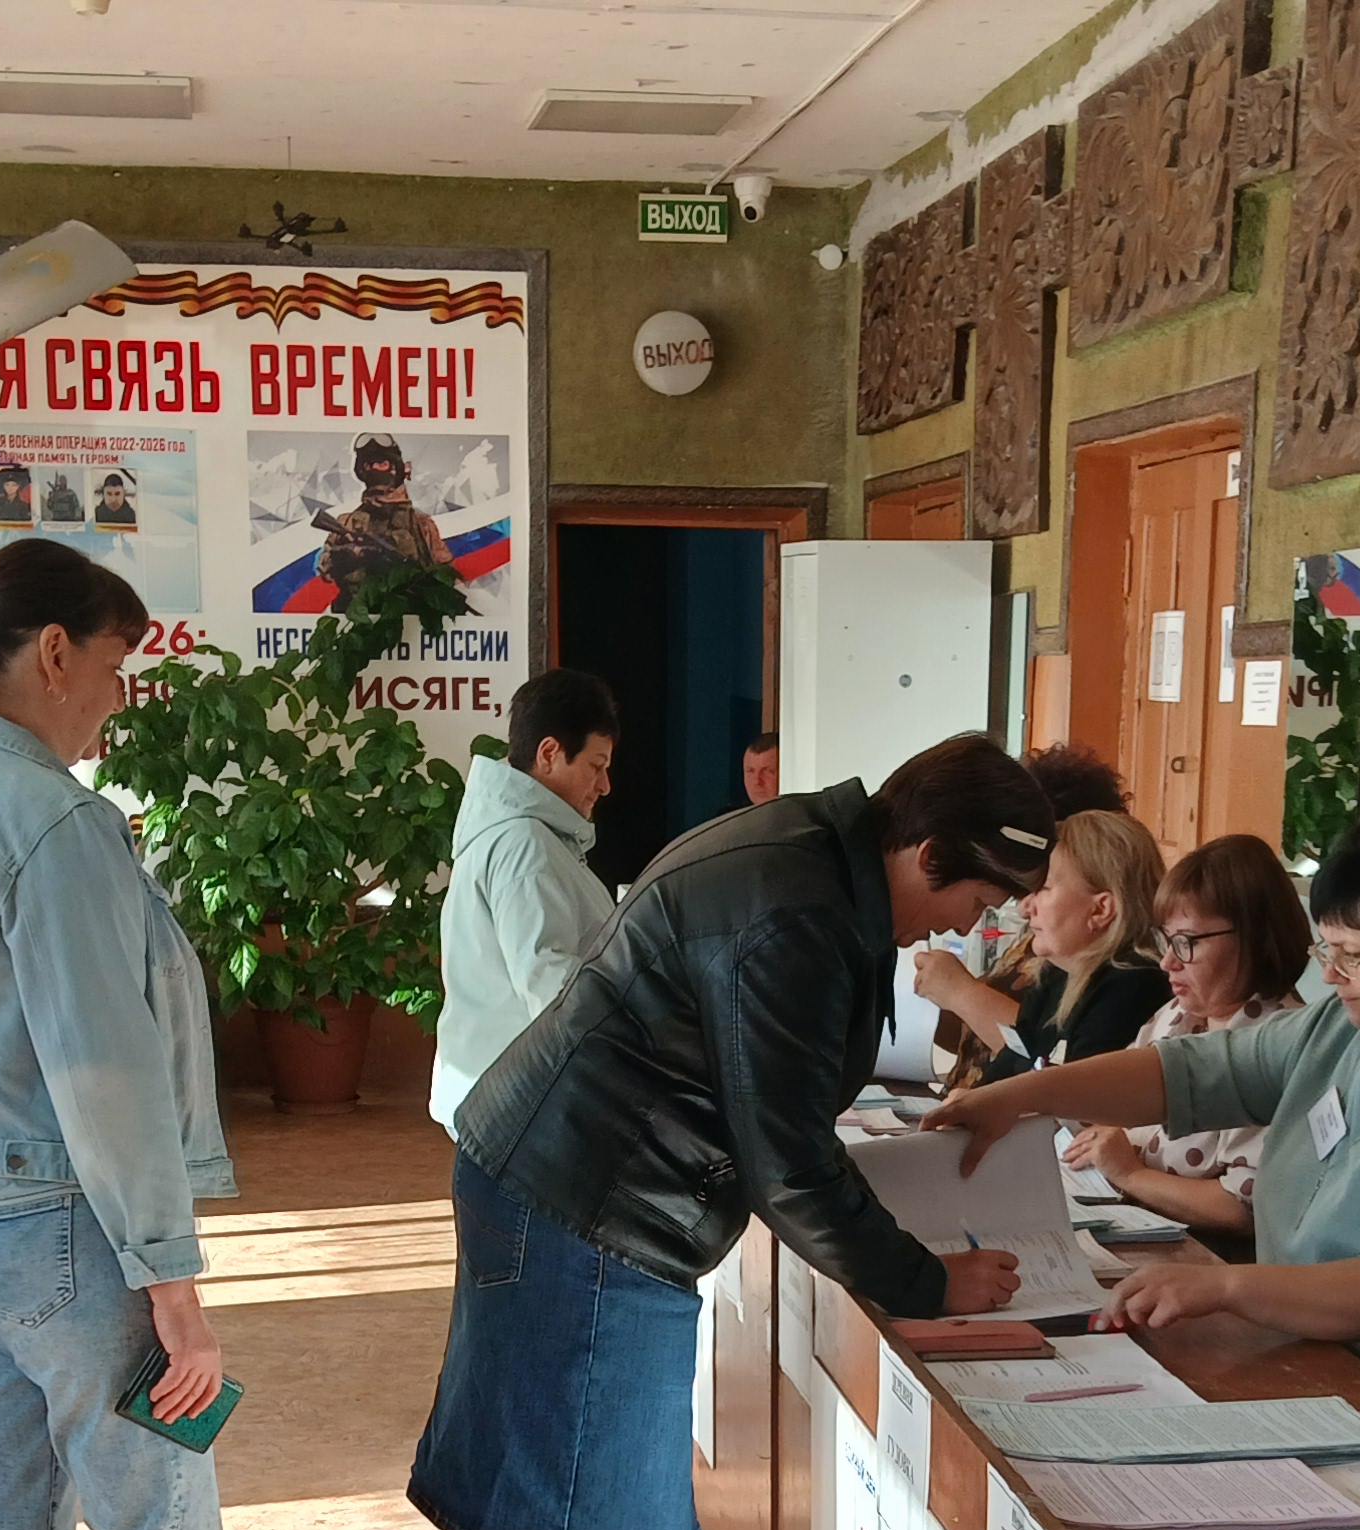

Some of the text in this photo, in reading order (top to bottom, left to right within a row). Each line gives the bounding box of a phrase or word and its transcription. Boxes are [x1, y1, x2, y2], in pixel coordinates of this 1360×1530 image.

[647, 203, 720, 233] ВЫХОД
[643, 338, 714, 369] ВЫХОД
[46, 338, 221, 413] СВЯЗЬ
[250, 343, 476, 419] ВРЕМЕН!
[8, 434, 54, 449] ВОЕННАЯ
[55, 435, 107, 450] ОПЕРАЦИЯ
[109, 437, 166, 452] 2022-2026
[38, 452, 78, 465] ПАМЯТЬ
[421, 630, 509, 662] РОССИИ
[353, 676, 502, 718] ИСЯГЕ,
